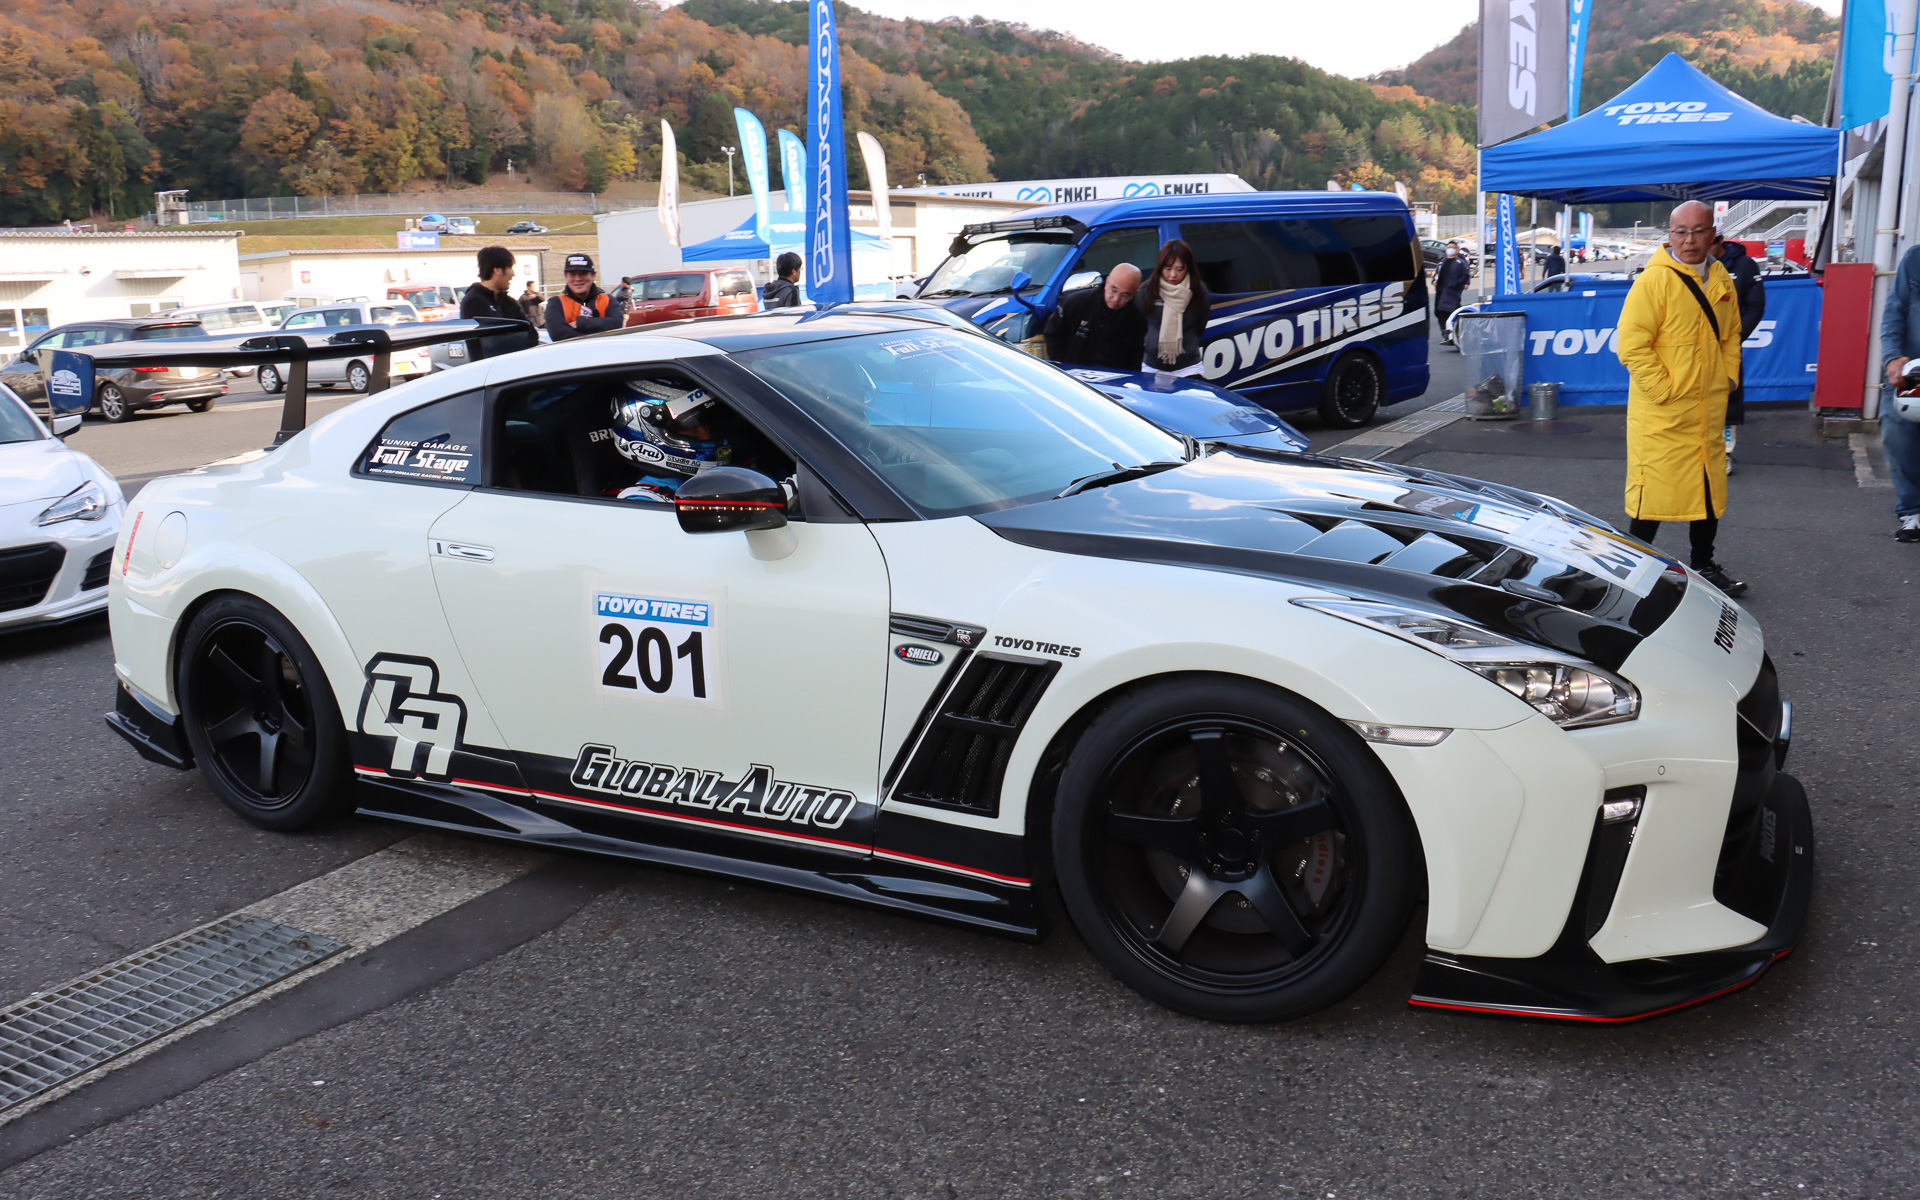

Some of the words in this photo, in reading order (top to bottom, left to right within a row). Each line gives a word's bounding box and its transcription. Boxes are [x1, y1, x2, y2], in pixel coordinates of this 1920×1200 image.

[1604, 101, 1708, 117] TOYO
[1617, 112, 1734, 126] TIRES
[1200, 318, 1295, 381] OYO
[1297, 281, 1404, 349] TIRES
[381, 438, 419, 447] TUNING
[422, 442, 468, 451] GARAGE
[632, 444, 660, 459] Arai
[369, 446, 413, 466] Full
[409, 449, 473, 474] Stage
[382, 469, 421, 478] PERFORMANCE
[598, 596, 649, 615] TOYO
[650, 601, 708, 621] TIRES
[994, 635, 1034, 651] TOYO
[1035, 641, 1082, 658] TIRES
[1714, 619, 1736, 655] TOYO
[599, 622, 707, 699] 201
[906, 647, 939, 662] SHIELD
